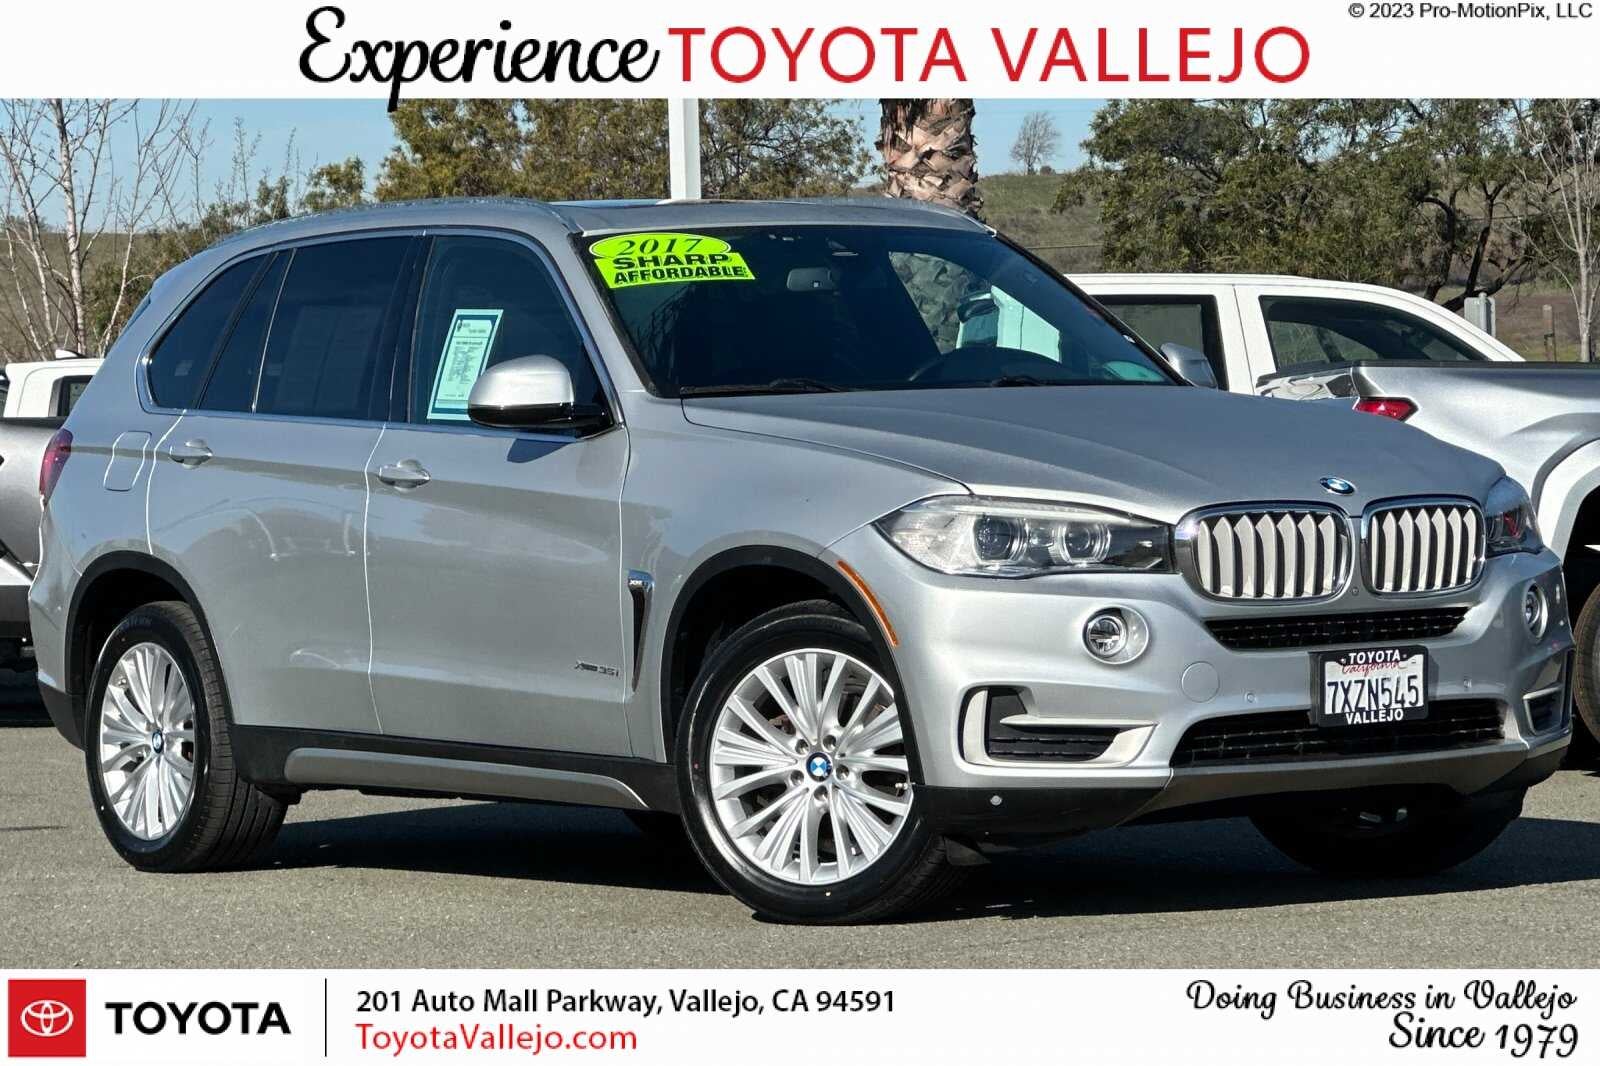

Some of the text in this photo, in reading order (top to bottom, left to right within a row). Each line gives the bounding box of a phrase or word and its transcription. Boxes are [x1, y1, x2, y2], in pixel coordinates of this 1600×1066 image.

[616, 238, 704, 256] 2017
[612, 253, 729, 270] SHARP
[614, 266, 745, 284] AFFORDABLE
[1349, 649, 1400, 664] TOYOTA
[1327, 675, 1419, 713] 7XZN545
[1346, 708, 1404, 725] VALLEJO
